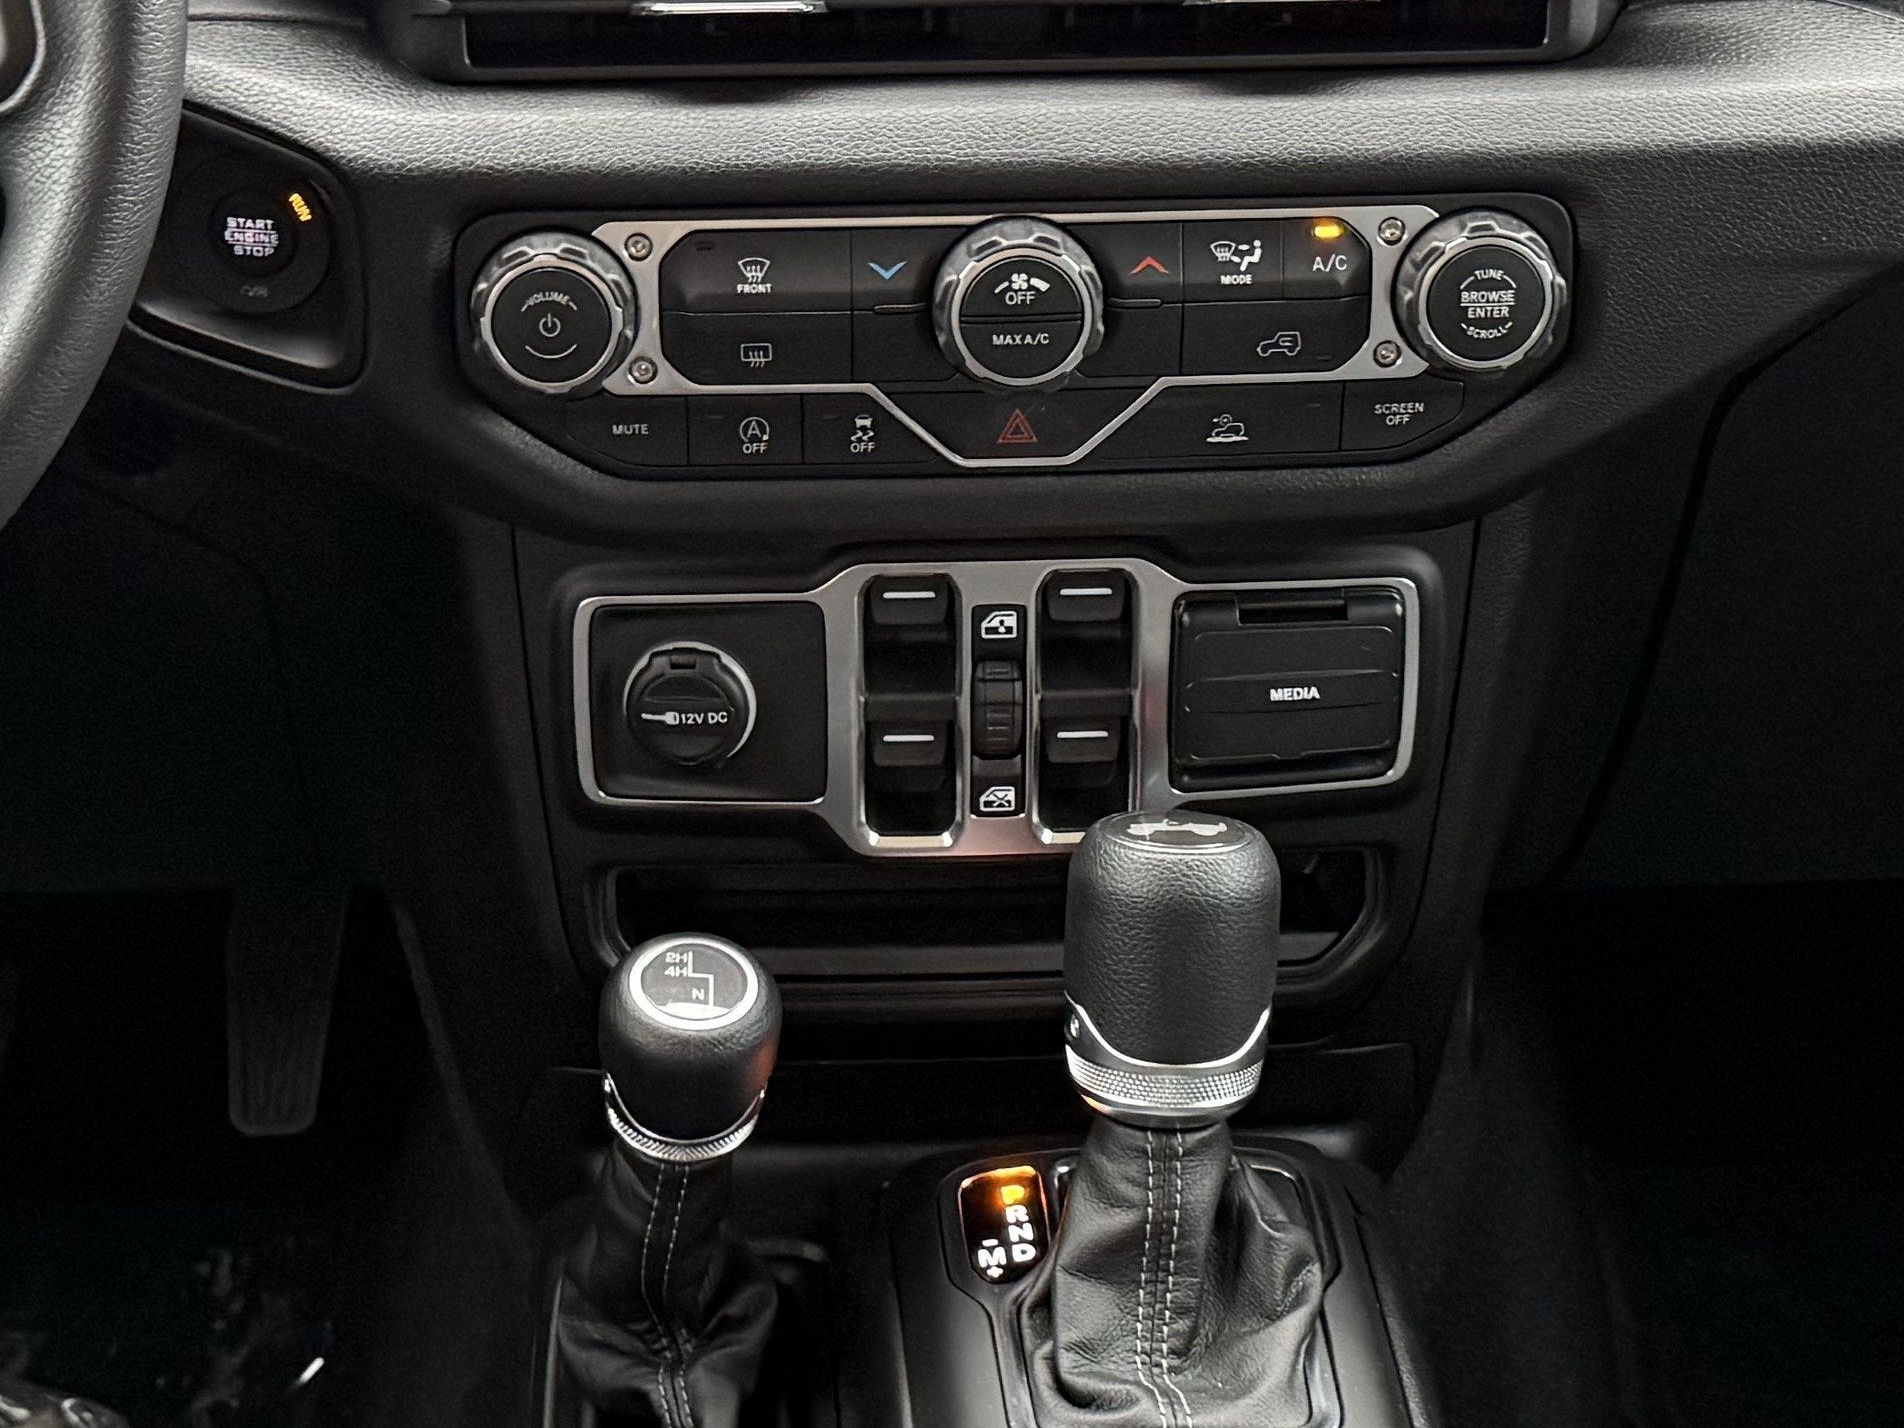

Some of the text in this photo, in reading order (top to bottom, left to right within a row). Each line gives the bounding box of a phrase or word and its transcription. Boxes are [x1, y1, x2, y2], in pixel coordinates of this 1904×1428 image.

[227, 217, 274, 229] START
[225, 230, 278, 245] ENGINE
[233, 246, 275, 257] STOP
[1312, 254, 1348, 272] A/C
[1220, 274, 1253, 285] MODE
[1474, 268, 1505, 281] TUNE
[736, 283, 772, 295] FRONT
[1005, 291, 1036, 305] OFF
[1460, 290, 1515, 303] BROWSE
[1467, 306, 1510, 319] ENTER
[992, 332, 1050, 346] MAX A/C
[1466, 325, 1508, 340] SCROLL
[1374, 402, 1425, 415] SCREEN
[1385, 415, 1411, 426] OFF
[612, 423, 649, 436] MUTE
[742, 442, 769, 455] OFF
[850, 442, 876, 454] OFF
[1269, 686, 1321, 702] MEDIA
[680, 711, 729, 725] 12V DC
[663, 965, 688, 978] 4H
[691, 988, 705, 1001] N
[1005, 1204, 1030, 1224] R
[1008, 1222, 1035, 1243] N
[977, 1246, 1008, 1268] M
[1011, 1242, 1037, 1263] D
